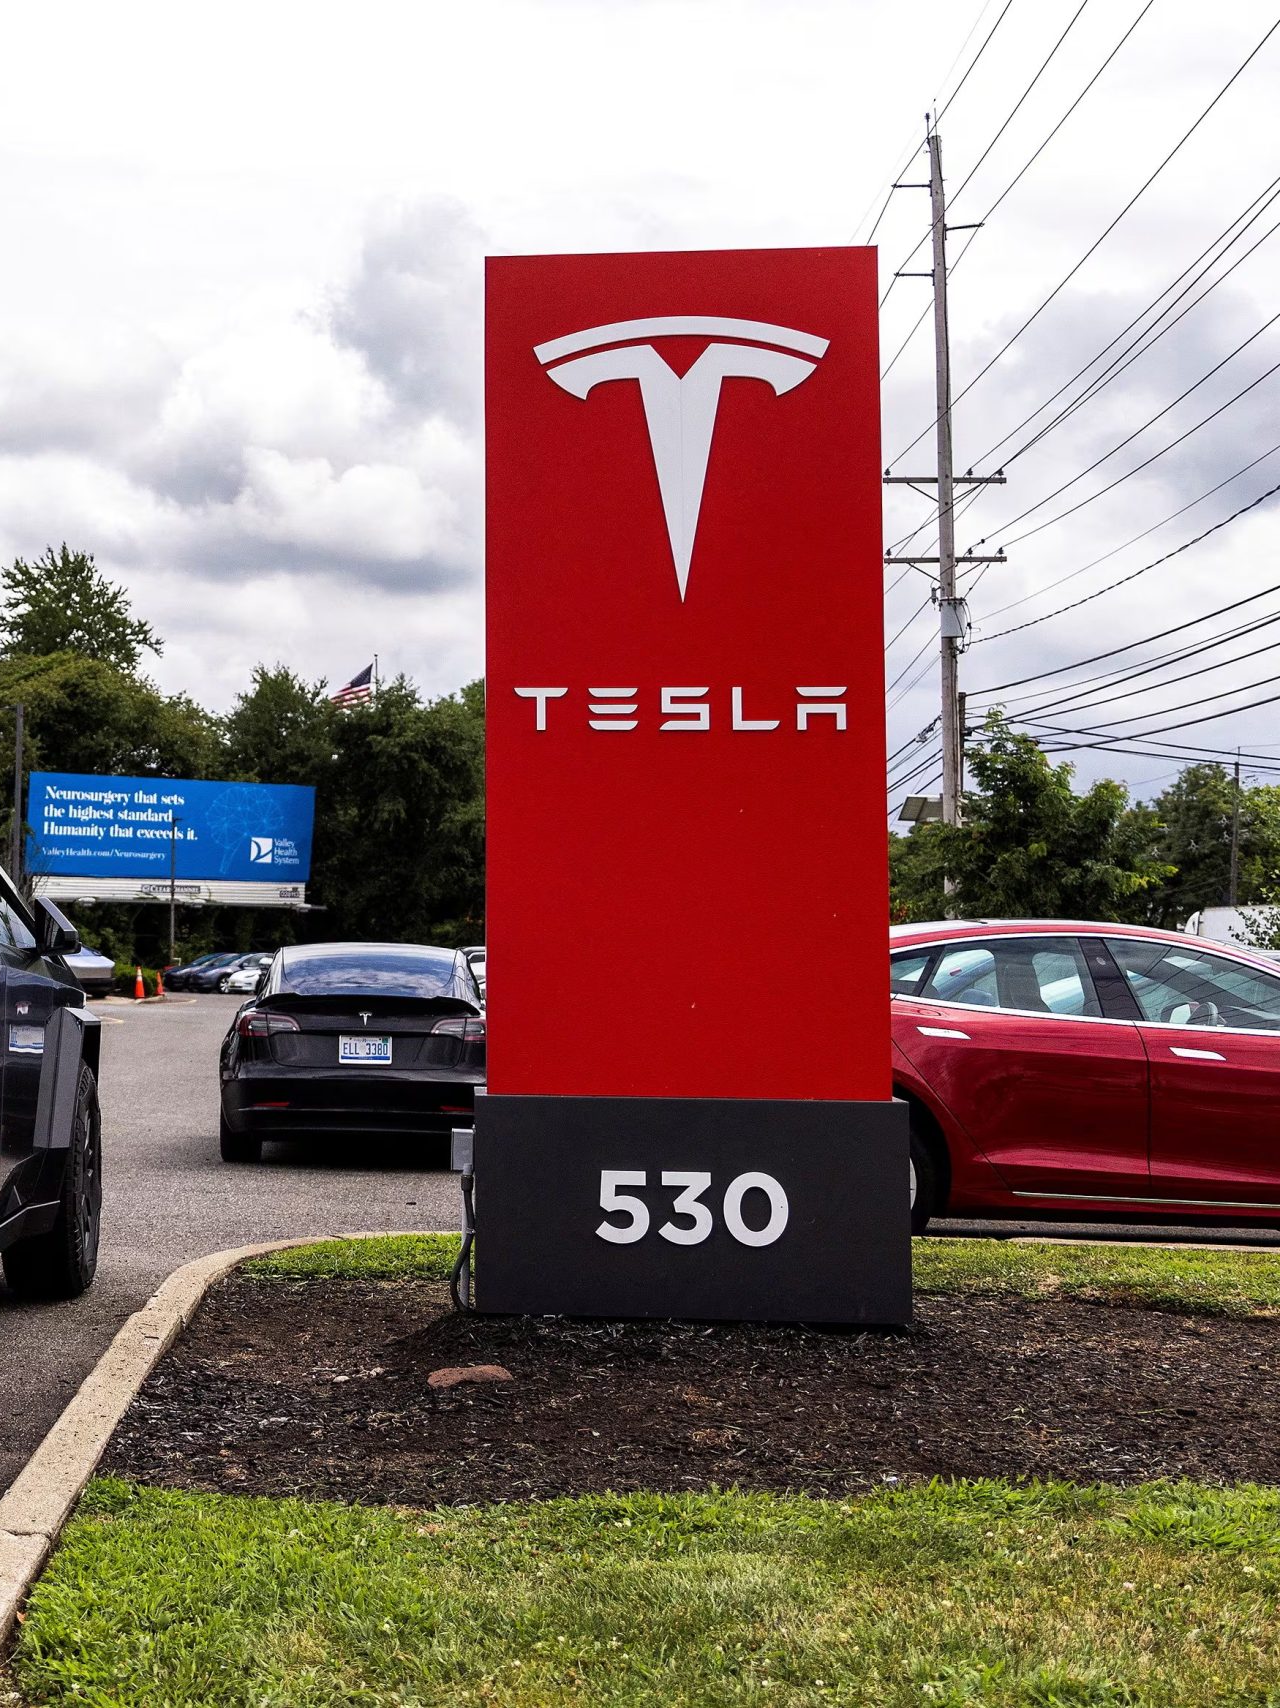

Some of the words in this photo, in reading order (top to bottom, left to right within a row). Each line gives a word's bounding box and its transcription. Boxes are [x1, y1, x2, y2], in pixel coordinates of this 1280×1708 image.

[514, 686, 848, 731] TESLA
[44, 785, 131, 806] Neurosurgery
[134, 790, 157, 805] that
[160, 793, 185, 806] sets
[44, 803, 65, 818] the
[68, 804, 114, 821] highest
[117, 808, 173, 822] standard
[43, 821, 106, 840] Humanity
[109, 824, 133, 838] that
[136, 826, 184, 840] exceeds
[186, 827, 198, 841] it.
[274, 838, 295, 848] Valley
[42, 847, 166, 860] ValleyHealth.com/Neurosurgery
[274, 847, 298, 856] Health
[274, 855, 300, 866] System
[343, 1042, 360, 1055] ELL
[595, 1168, 790, 1248] 530
